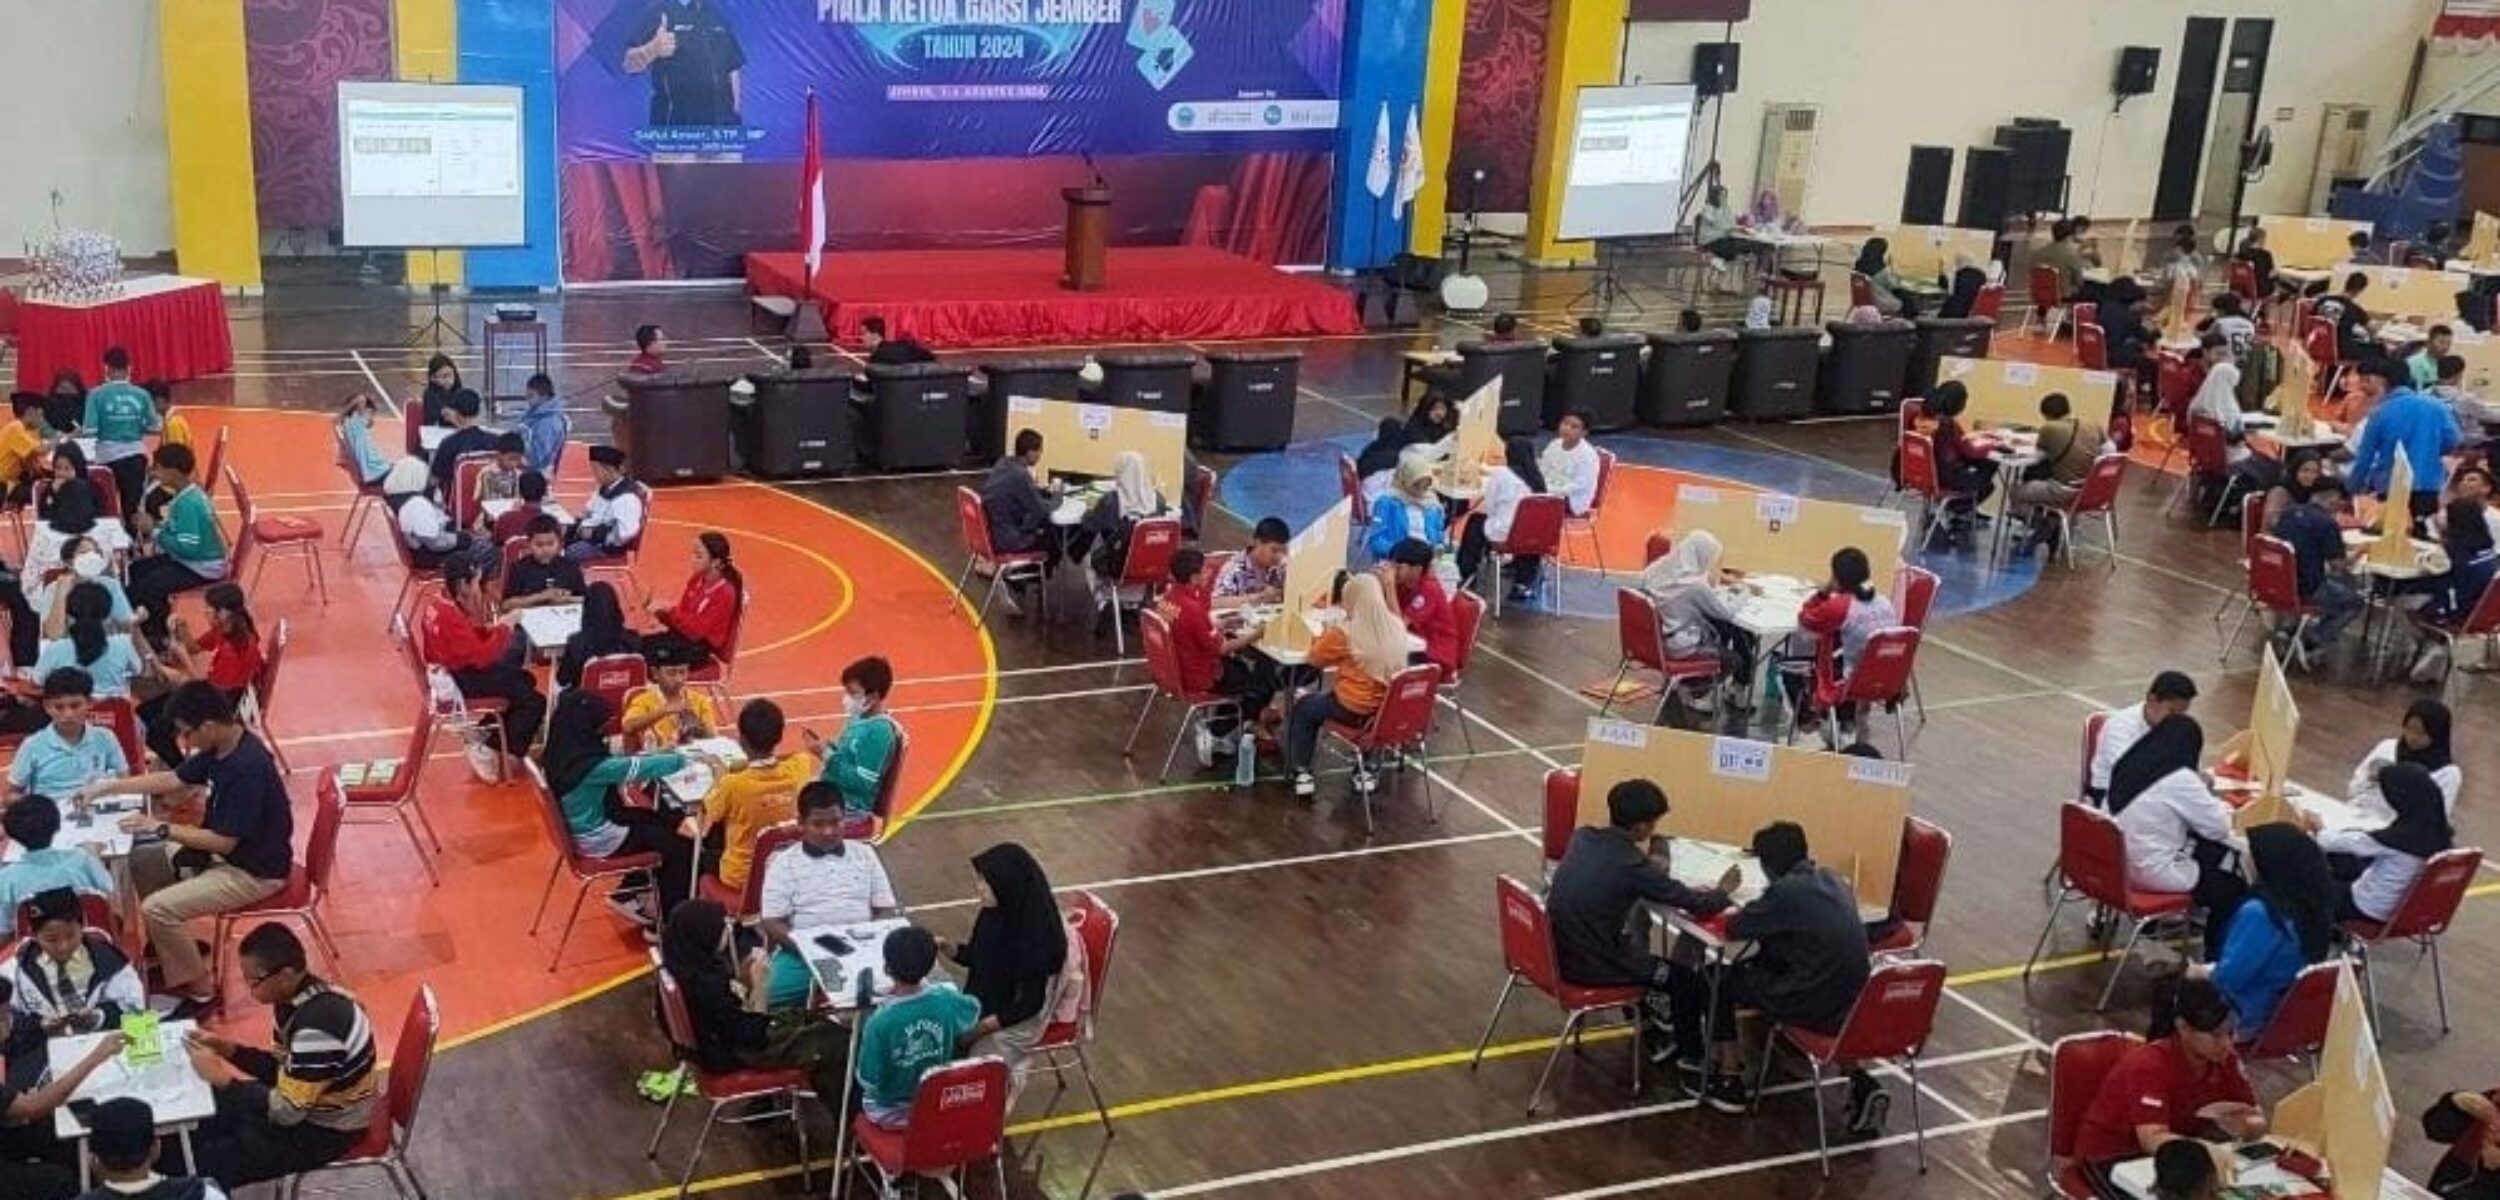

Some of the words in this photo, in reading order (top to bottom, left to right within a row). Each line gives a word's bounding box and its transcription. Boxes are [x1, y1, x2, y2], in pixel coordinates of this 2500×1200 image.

[817, 0, 881, 23] PIALA
[889, 0, 958, 23] KETUA
[965, 0, 1029, 24] GABSI
[1034, 0, 1122, 24] JEMBER
[922, 34, 976, 58] TAHUN
[980, 34, 1024, 58] 2024
